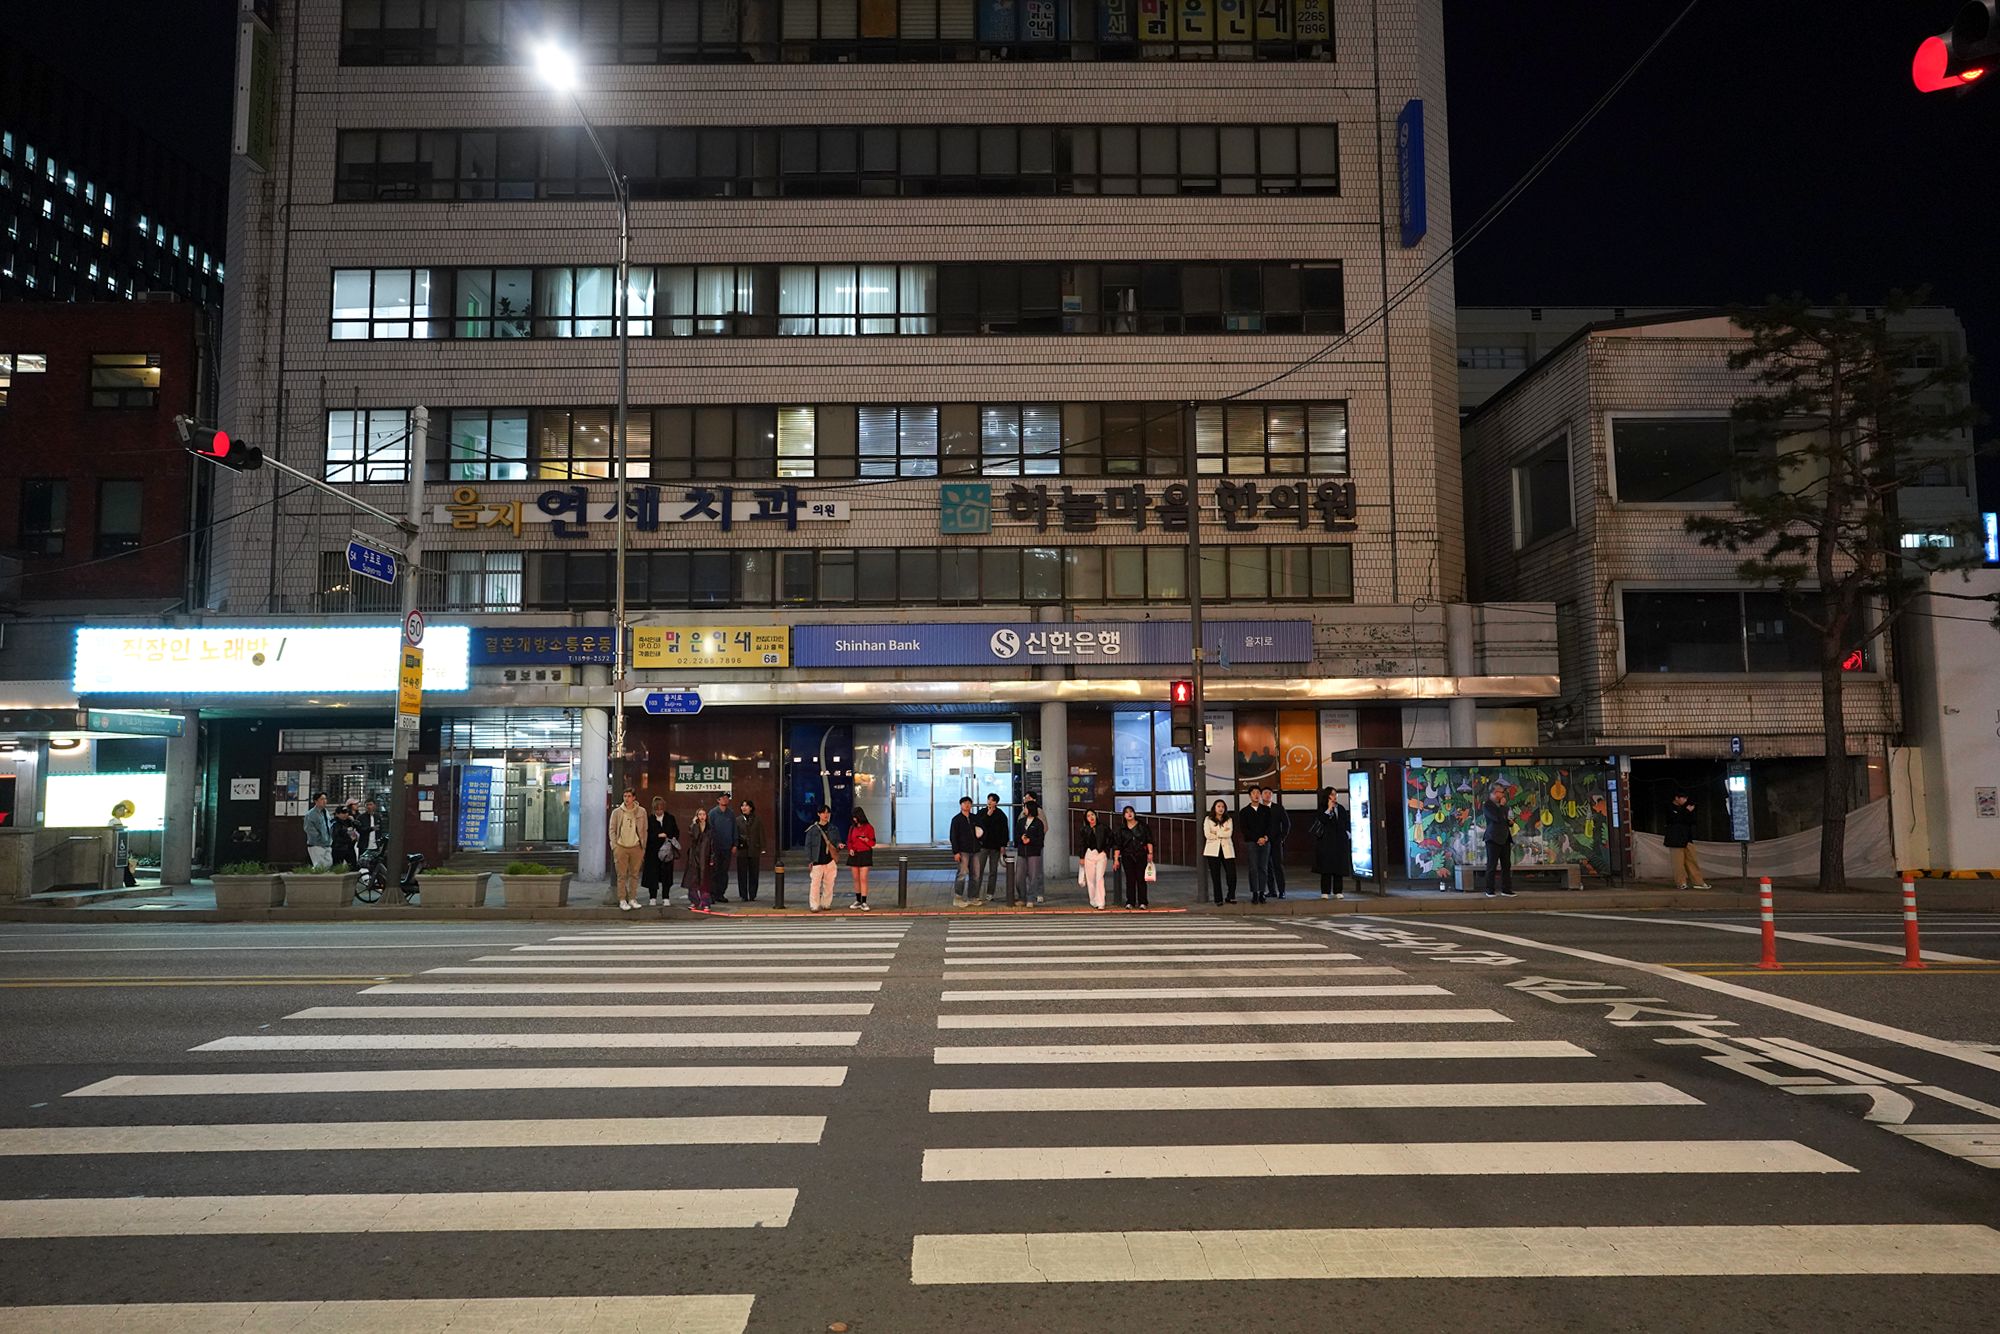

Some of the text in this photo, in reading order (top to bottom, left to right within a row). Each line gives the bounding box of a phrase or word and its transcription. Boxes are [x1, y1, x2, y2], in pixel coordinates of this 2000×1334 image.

[1297, 12, 1326, 22] 2265
[1028, 20, 1055, 38] 인쇄
[1298, 24, 1326, 34] 7896
[445, 486, 836, 539] 을지 연세치과 의원
[409, 619, 421, 637] 50
[835, 639, 920, 652] Shinhan Bank
[1024, 630, 1122, 655] 신한은행
[1244, 635, 1275, 647] 을지로
[122, 637, 192, 662] 직장인
[702, 766, 730, 781] 임대
